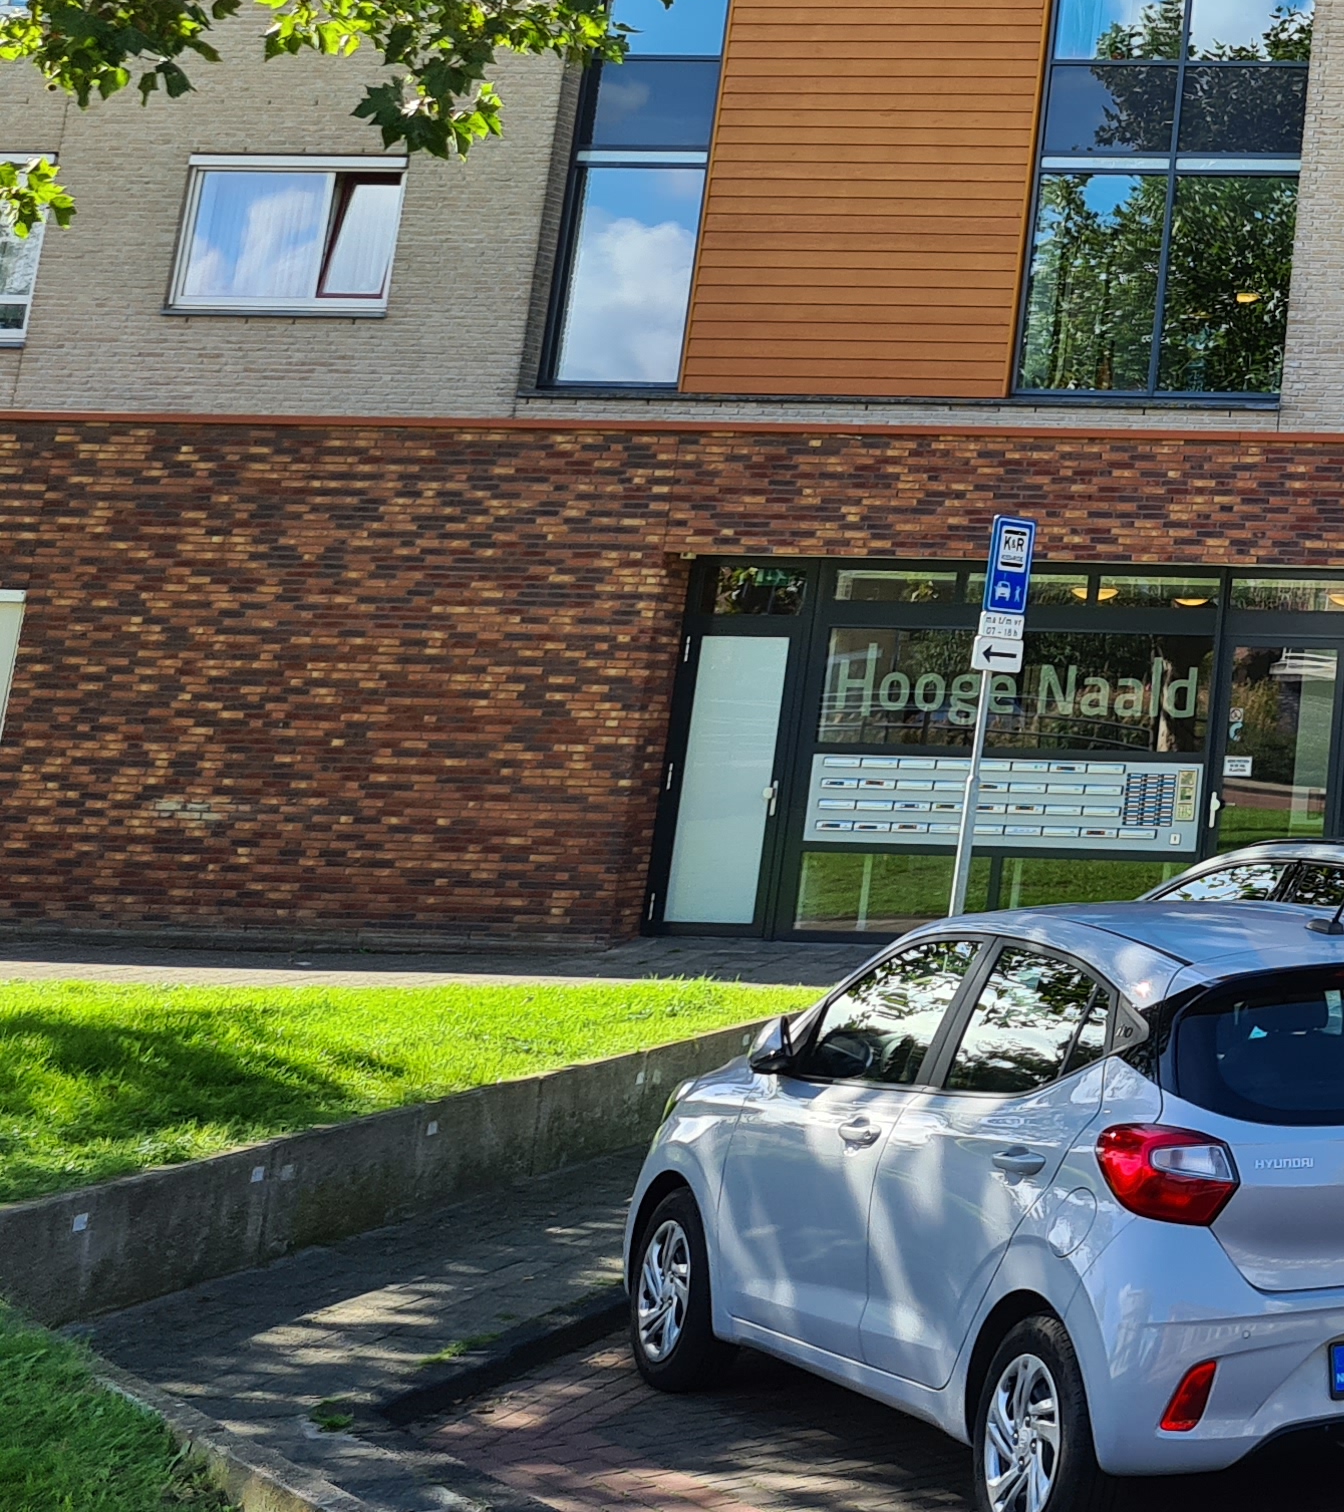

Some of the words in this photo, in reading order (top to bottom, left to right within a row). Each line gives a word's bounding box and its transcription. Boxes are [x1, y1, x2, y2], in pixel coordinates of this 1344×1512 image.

[1003, 535, 1025, 552] K&R
[998, 616, 1012, 625] t/m
[986, 626, 996, 635] 07
[835, 642, 1017, 726] Hooge
[1037, 656, 1199, 719] Naald
[1255, 1156, 1315, 1169] HYUNDAI
